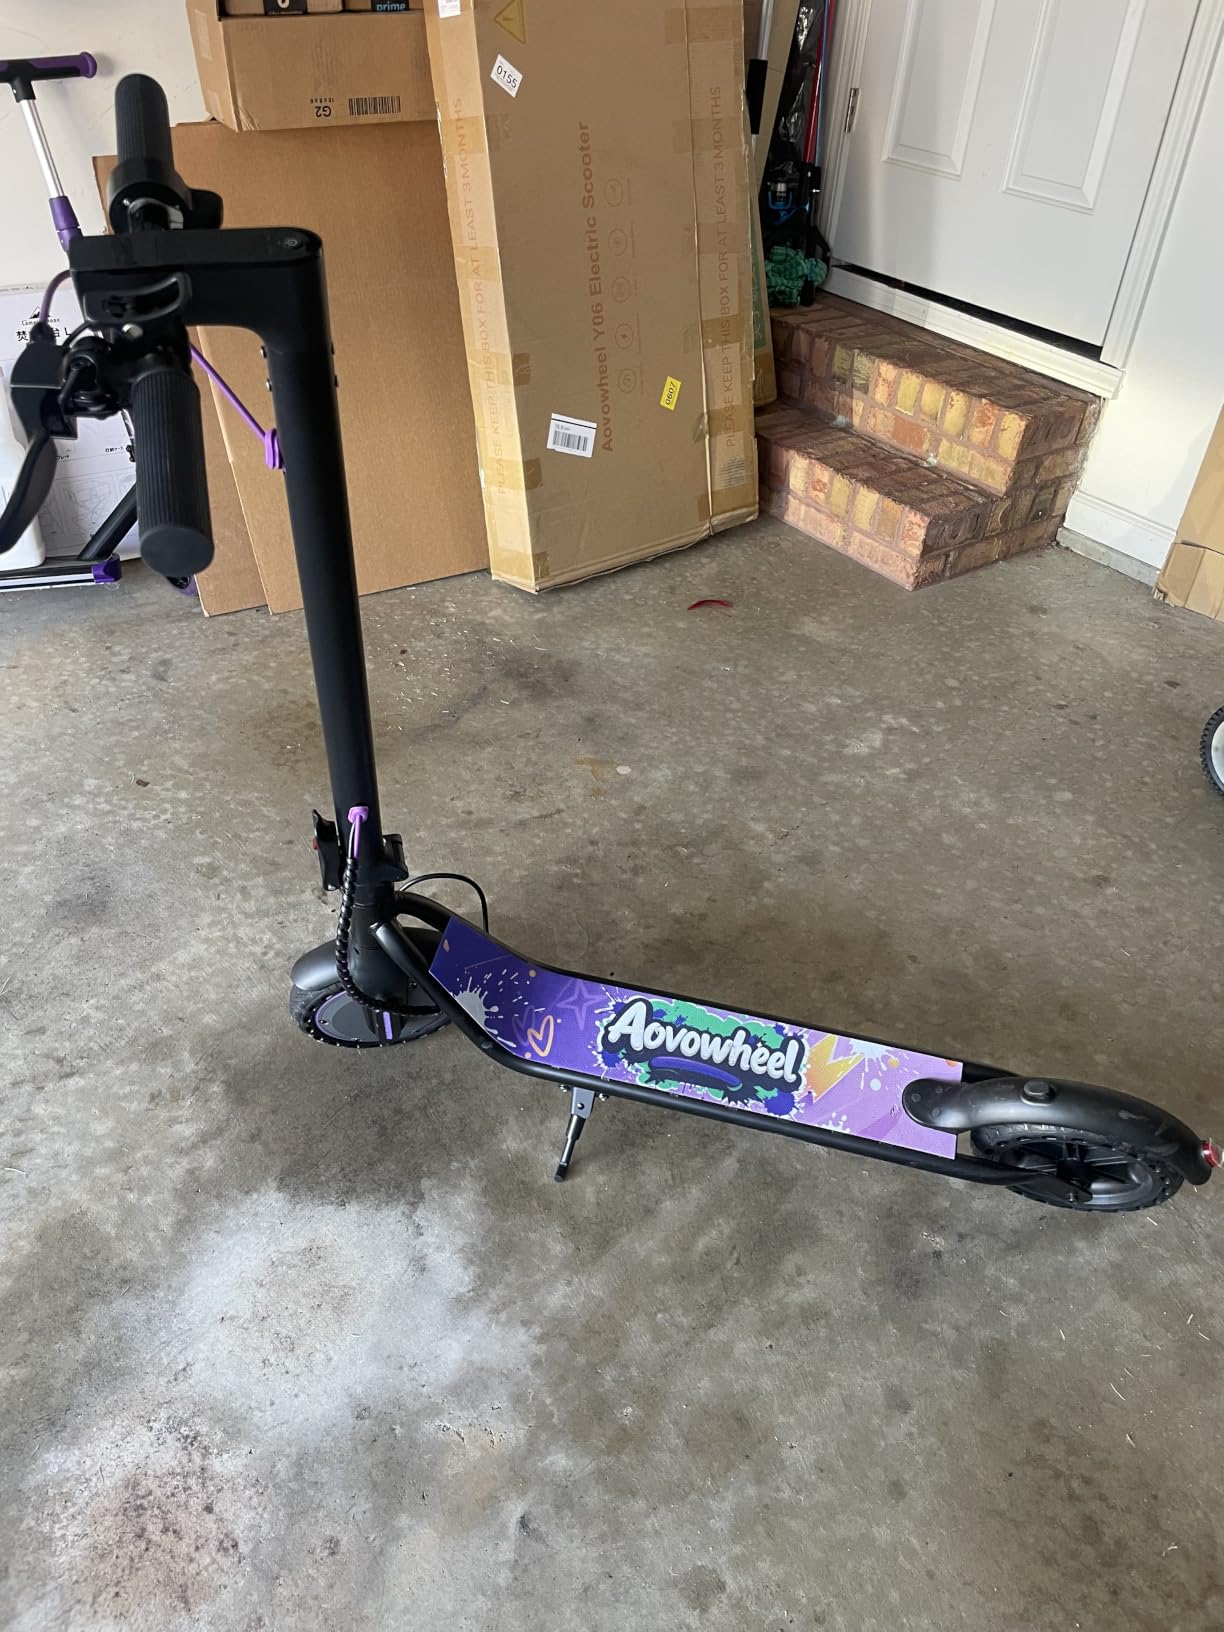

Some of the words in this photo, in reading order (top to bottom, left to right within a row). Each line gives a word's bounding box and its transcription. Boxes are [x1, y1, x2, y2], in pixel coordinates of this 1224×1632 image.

[497, 65, 517, 88] 0155
[315, 105, 331, 118] G2
[711, 86, 724, 158] MONTHS
[453, 98, 471, 178] MONTHS
[579, 121, 595, 208] Scooter
[713, 162, 724, 171] 3
[462, 182, 471, 193] 3
[714, 176, 727, 224] LEAST
[464, 198, 478, 251] LEAST
[717, 230, 728, 248] AT
[470, 255, 482, 277] AT
[585, 215, 602, 296] Electric
[718, 250, 729, 286] FOR
[473, 281, 487, 315] FOR
[720, 290, 730, 319] BOX
[478, 318, 490, 352] BOX
[591, 302, 606, 341] Y06
[720, 319, 731, 350] THIS
[482, 355, 496, 393] THIS
[722, 356, 733, 393] KEEP
[594, 346, 613, 452] Aovowheel
[665, 381, 676, 405] 0607
[487, 395, 500, 434] KEEP
[725, 395, 736, 448] PLEASE
[493, 439, 507, 494] PLEASE
[608, 1000, 798, 1084] Aovowheel
